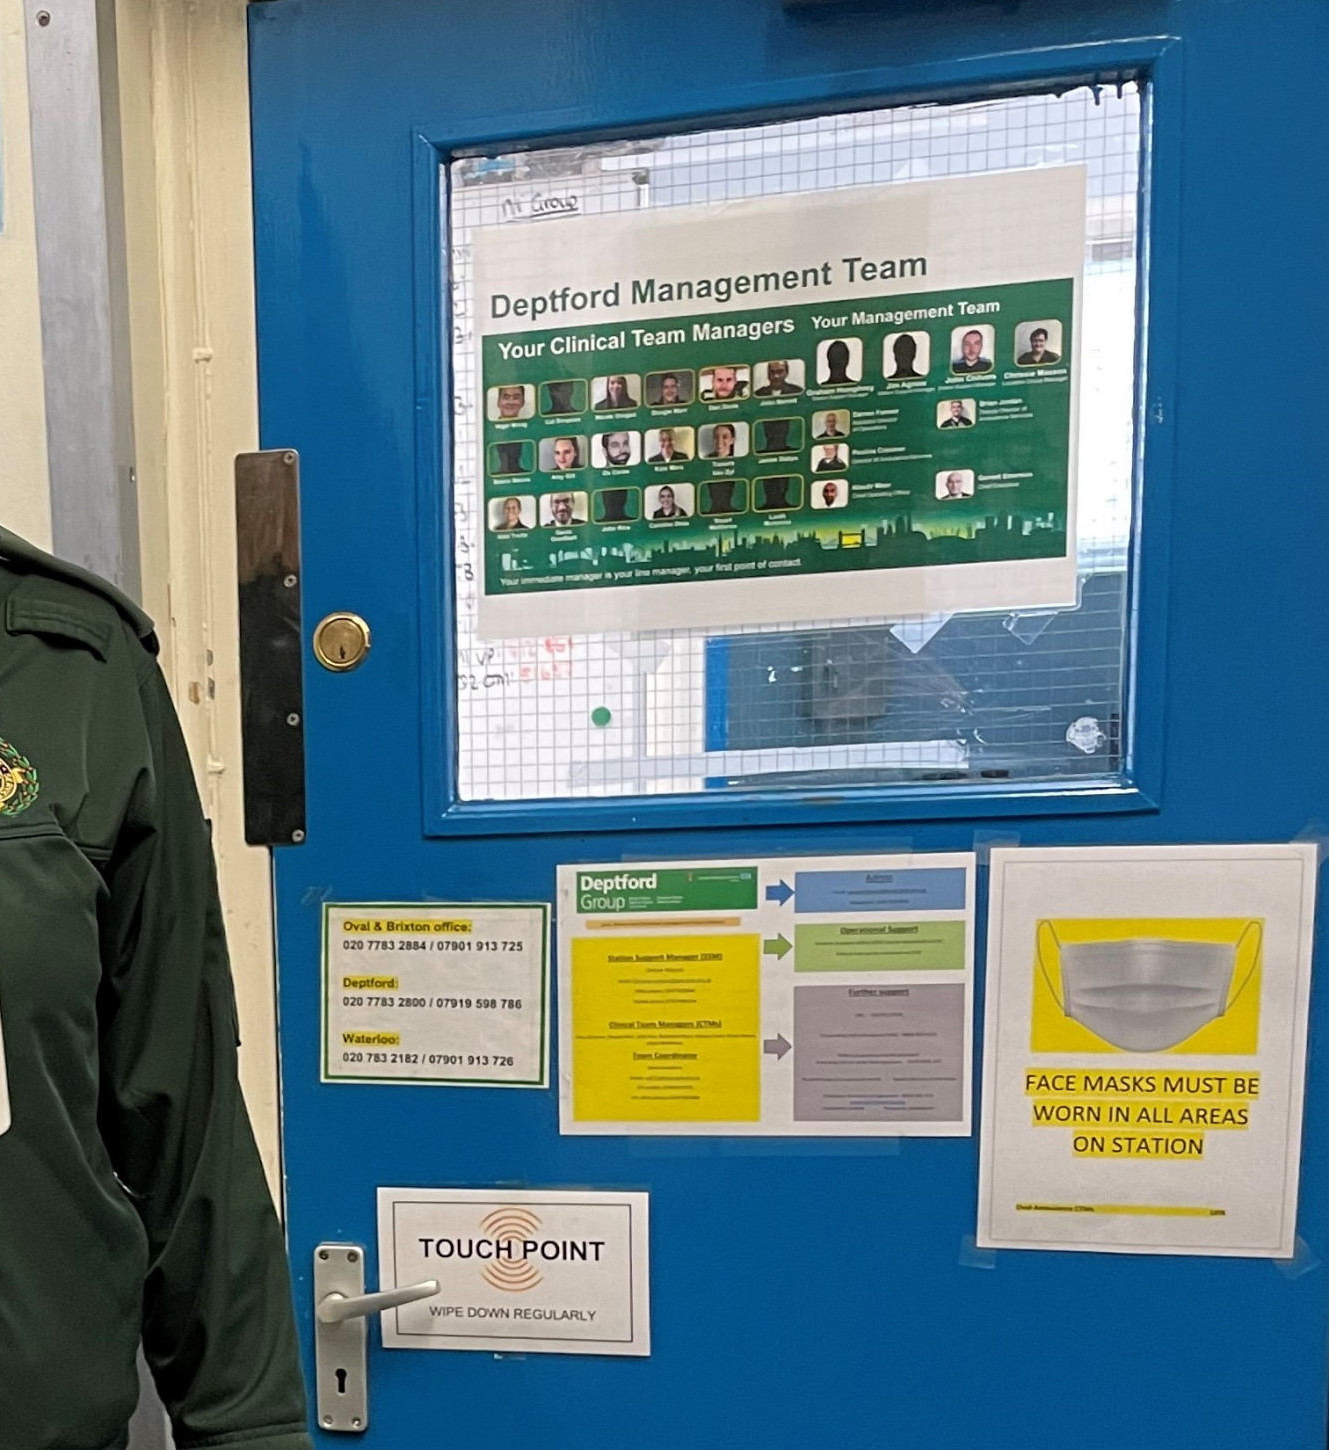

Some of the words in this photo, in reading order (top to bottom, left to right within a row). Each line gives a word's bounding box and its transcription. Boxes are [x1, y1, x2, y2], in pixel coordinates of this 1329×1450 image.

[490, 282, 621, 321] Deptford
[630, 261, 833, 305] Management
[842, 255, 927, 284] Team
[811, 315, 847, 330] Your
[852, 303, 955, 328] Management
[959, 299, 1001, 316] Team
[499, 341, 545, 360] Your
[549, 330, 626, 355] Clinical
[631, 326, 686, 348] Team
[692, 316, 795, 348] Managers
[581, 873, 657, 894] Deptford
[581, 894, 625, 912] Group
[343, 922, 370, 932] Oval
[374, 922, 382, 932] &
[387, 922, 430, 932] Brixton
[434, 922, 471, 932] office:
[343, 940, 364, 950] 020
[367, 940, 395, 950] 7783
[398, 940, 426, 951] 2884
[429, 940, 434, 951] /
[437, 941, 471, 951] 07901
[477, 941, 497, 951] 913
[502, 941, 523, 951] 725
[343, 977, 398, 989] Deptford:
[343, 997, 363, 1007] 020
[367, 997, 394, 1007] 7783
[398, 997, 426, 1008] 2800
[429, 997, 433, 1008] /
[436, 998, 472, 1008] 07919
[476, 998, 497, 1008] 598
[501, 998, 522, 1009] 786
[343, 1033, 400, 1045] Waterloo:
[343, 1053, 363, 1063] 020
[367, 1053, 387, 1063] 783
[391, 1053, 418, 1064] 2182
[422, 1053, 426, 1064] /
[429, 1054, 463, 1065] 07901
[468, 1054, 489, 1065] 913
[492, 1055, 514, 1066] 726
[1026, 1074, 1076, 1092] FACE
[1083, 1075, 1156, 1093] MASKS
[1163, 1077, 1227, 1094] MUST
[1234, 1077, 1259, 1095] BE
[1033, 1105, 1101, 1122] WORN
[1108, 1106, 1130, 1123] IN
[1136, 1107, 1173, 1124] ALL
[1180, 1108, 1248, 1125] AREAS
[1073, 1136, 1104, 1153] ON
[1111, 1136, 1203, 1154] STATION
[419, 1238, 512, 1260] TOUCH
[522, 1240, 605, 1261] POINT
[429, 1305, 464, 1318] WIPE
[467, 1307, 510, 1319] DOWN
[513, 1308, 596, 1321] REGULARLY
